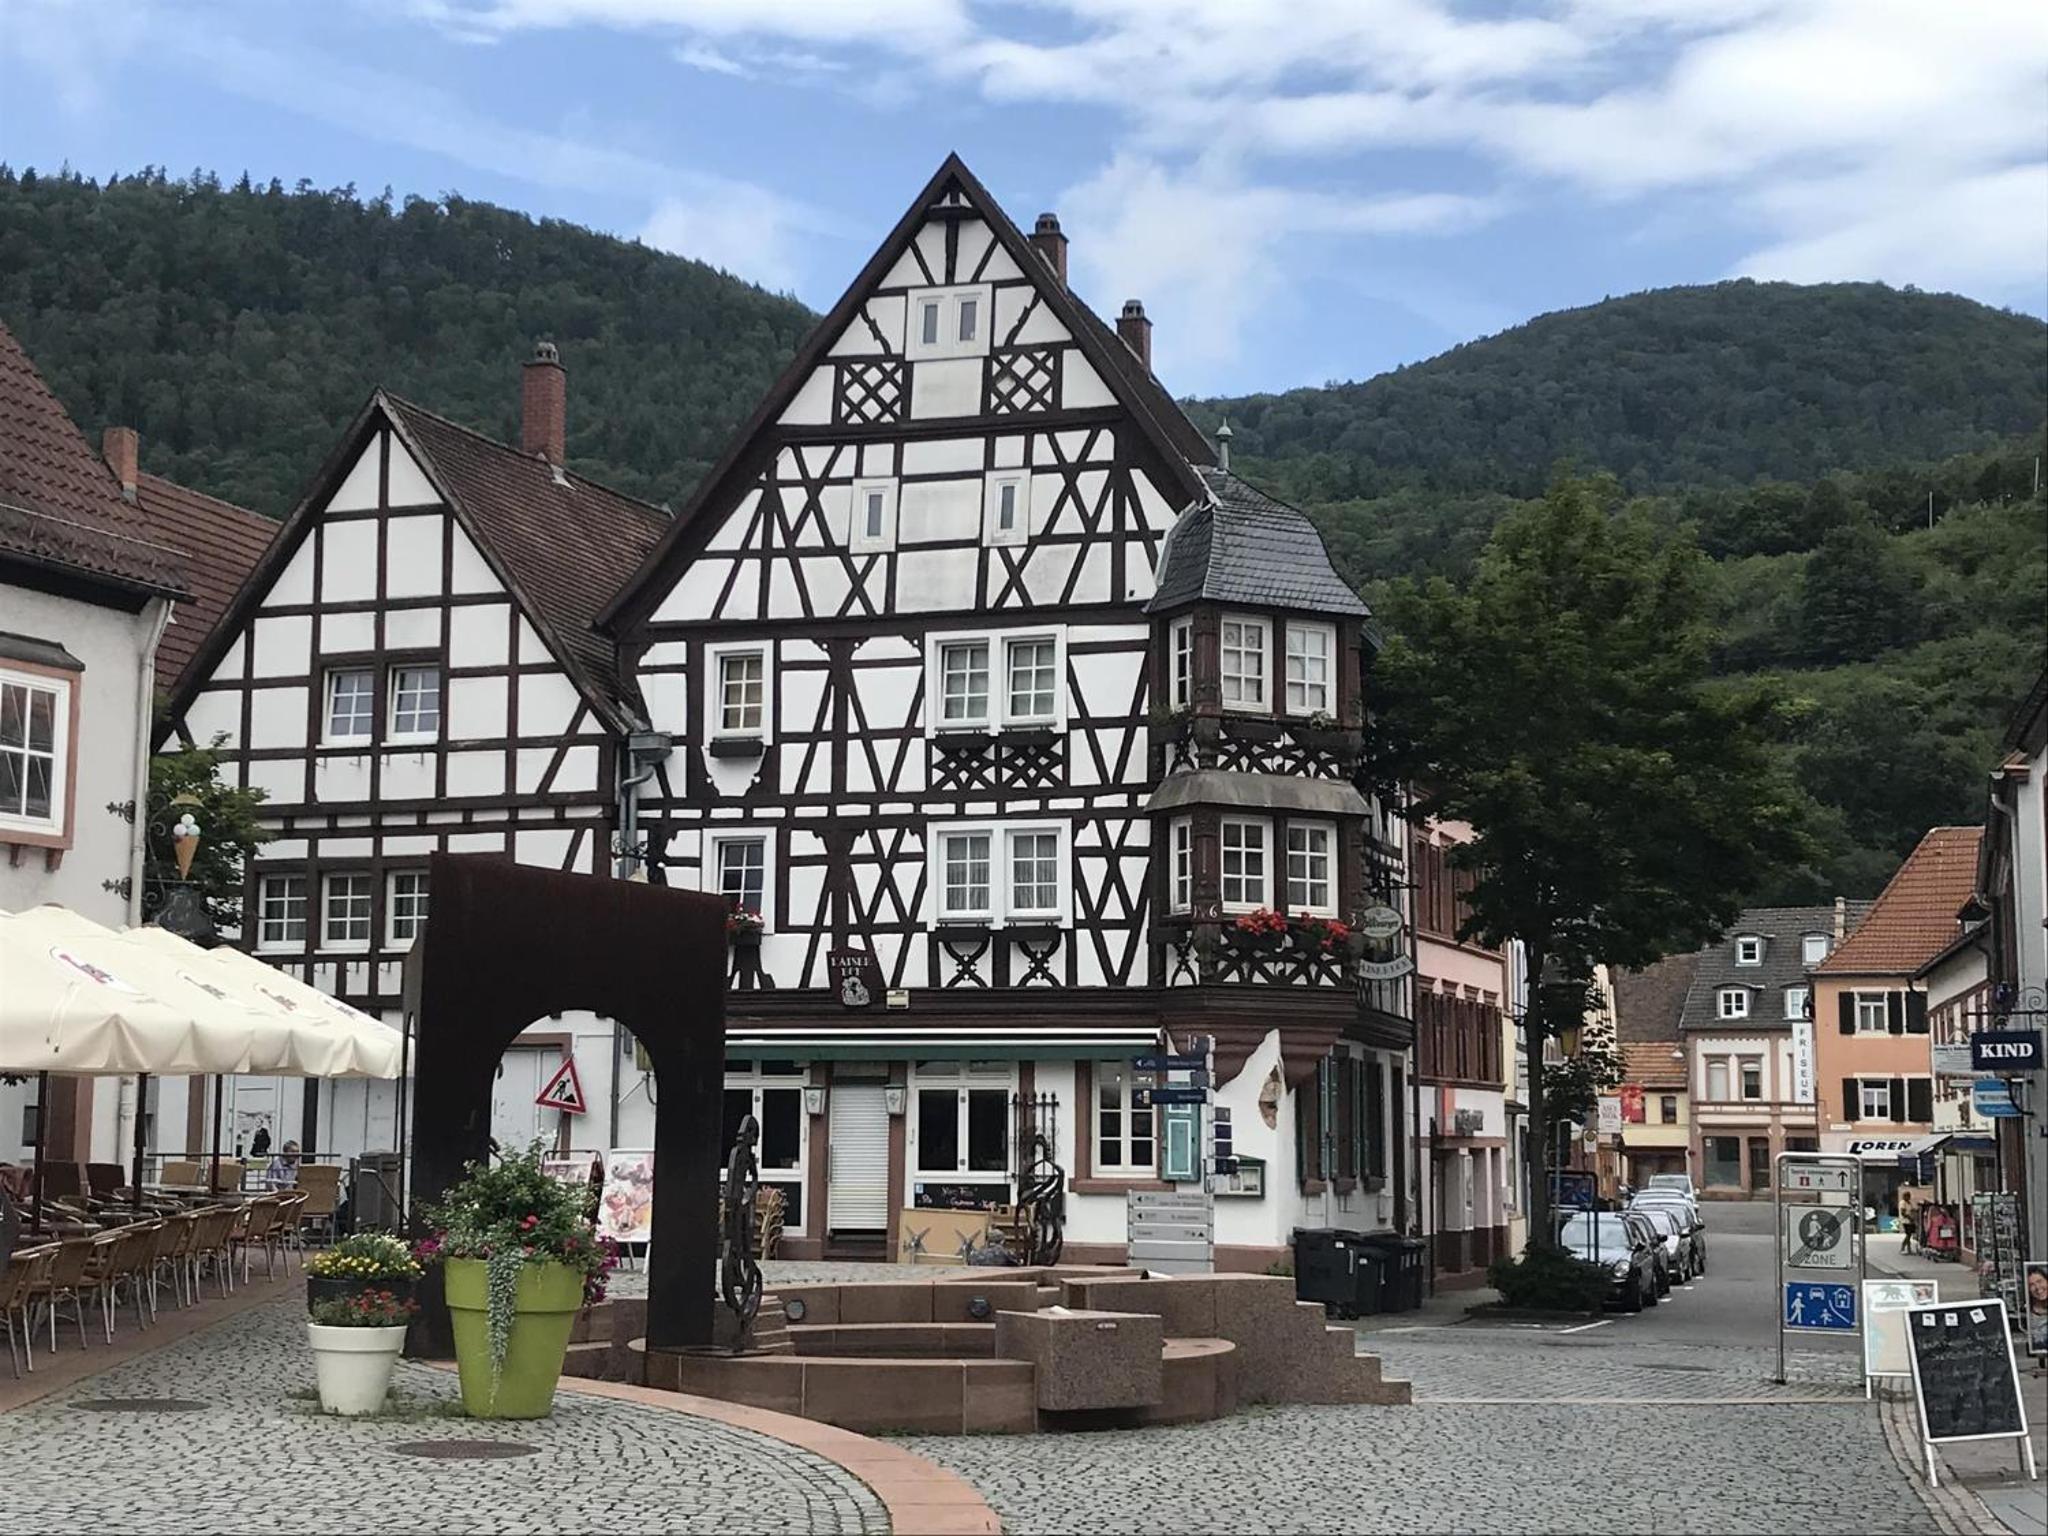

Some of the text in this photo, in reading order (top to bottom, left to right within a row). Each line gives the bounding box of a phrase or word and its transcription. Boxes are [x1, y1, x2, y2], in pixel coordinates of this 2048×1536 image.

[1980, 1042, 2034, 1059] KIND
[1799, 1028, 1809, 1098] FRISEUR
[1803, 1254, 1837, 1266] ZONE
